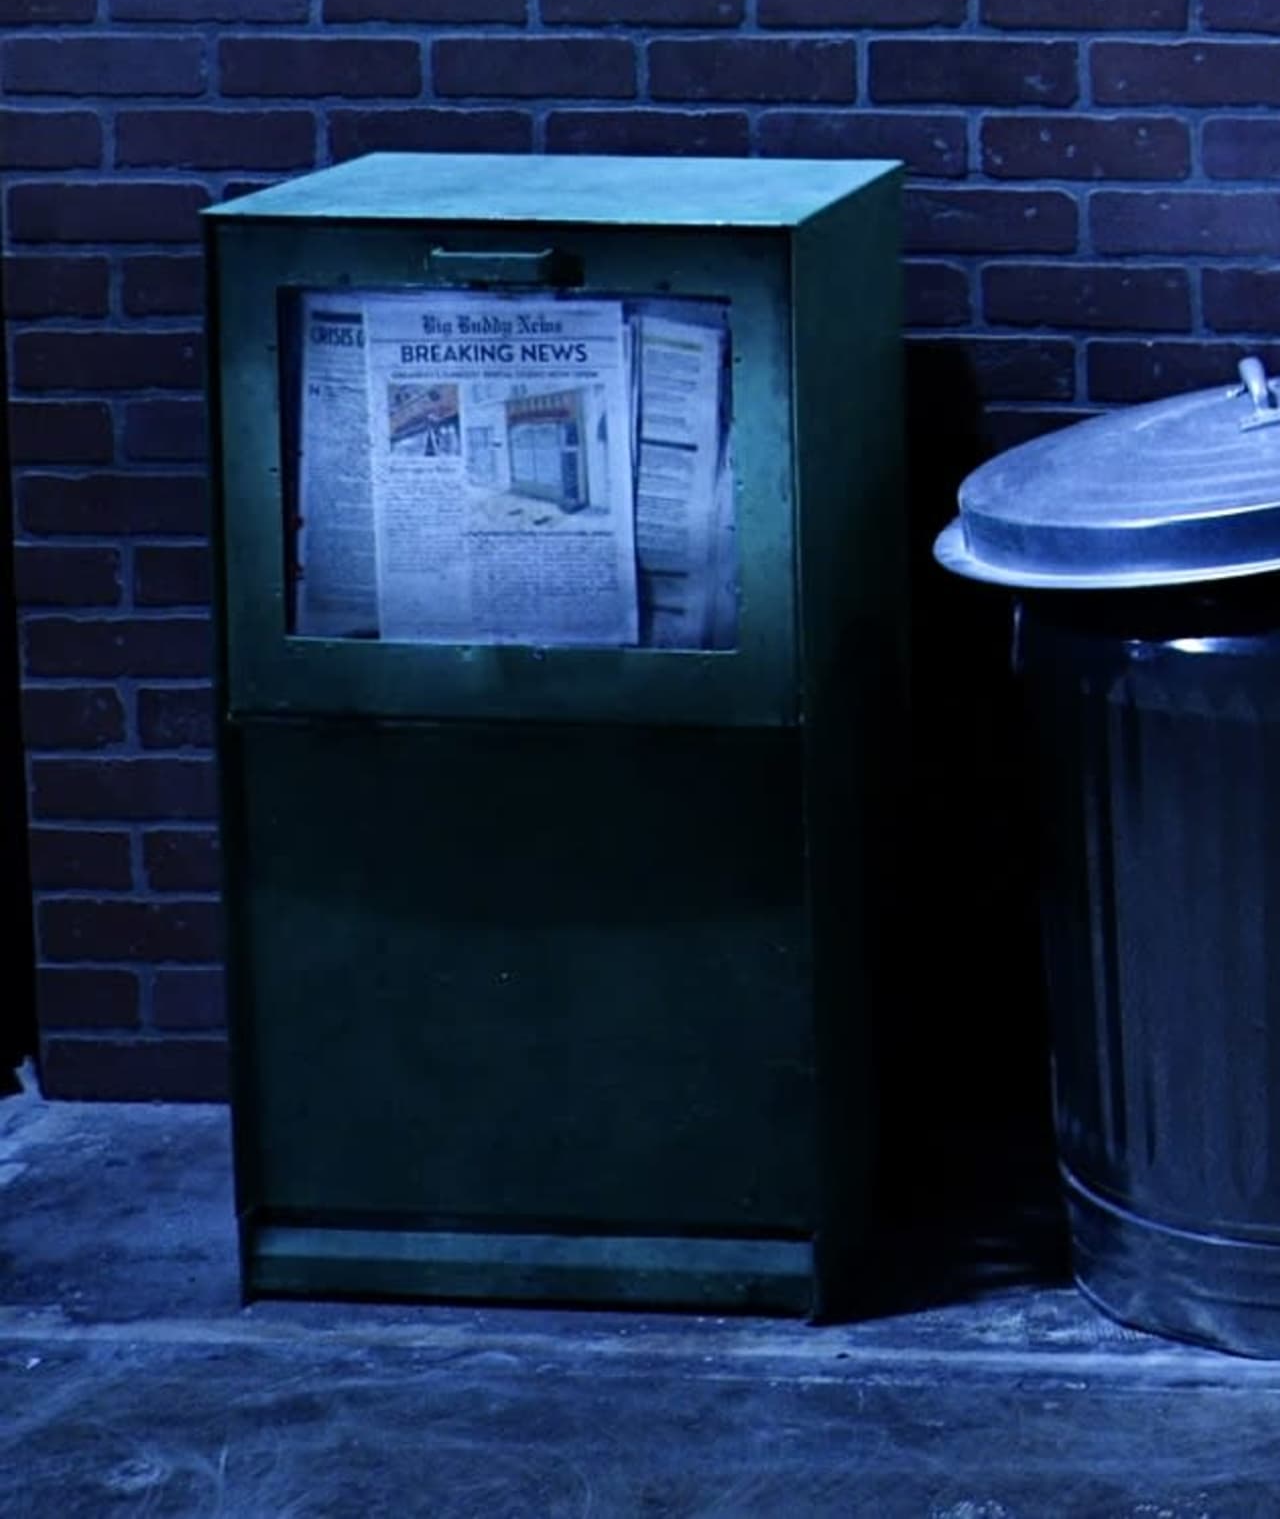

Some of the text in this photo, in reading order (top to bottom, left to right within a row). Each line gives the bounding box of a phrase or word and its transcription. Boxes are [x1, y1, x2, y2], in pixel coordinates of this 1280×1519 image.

[421, 314, 453, 337] Big
[457, 314, 512, 337] Buddy
[401, 344, 588, 363] BREAKING NEWS
